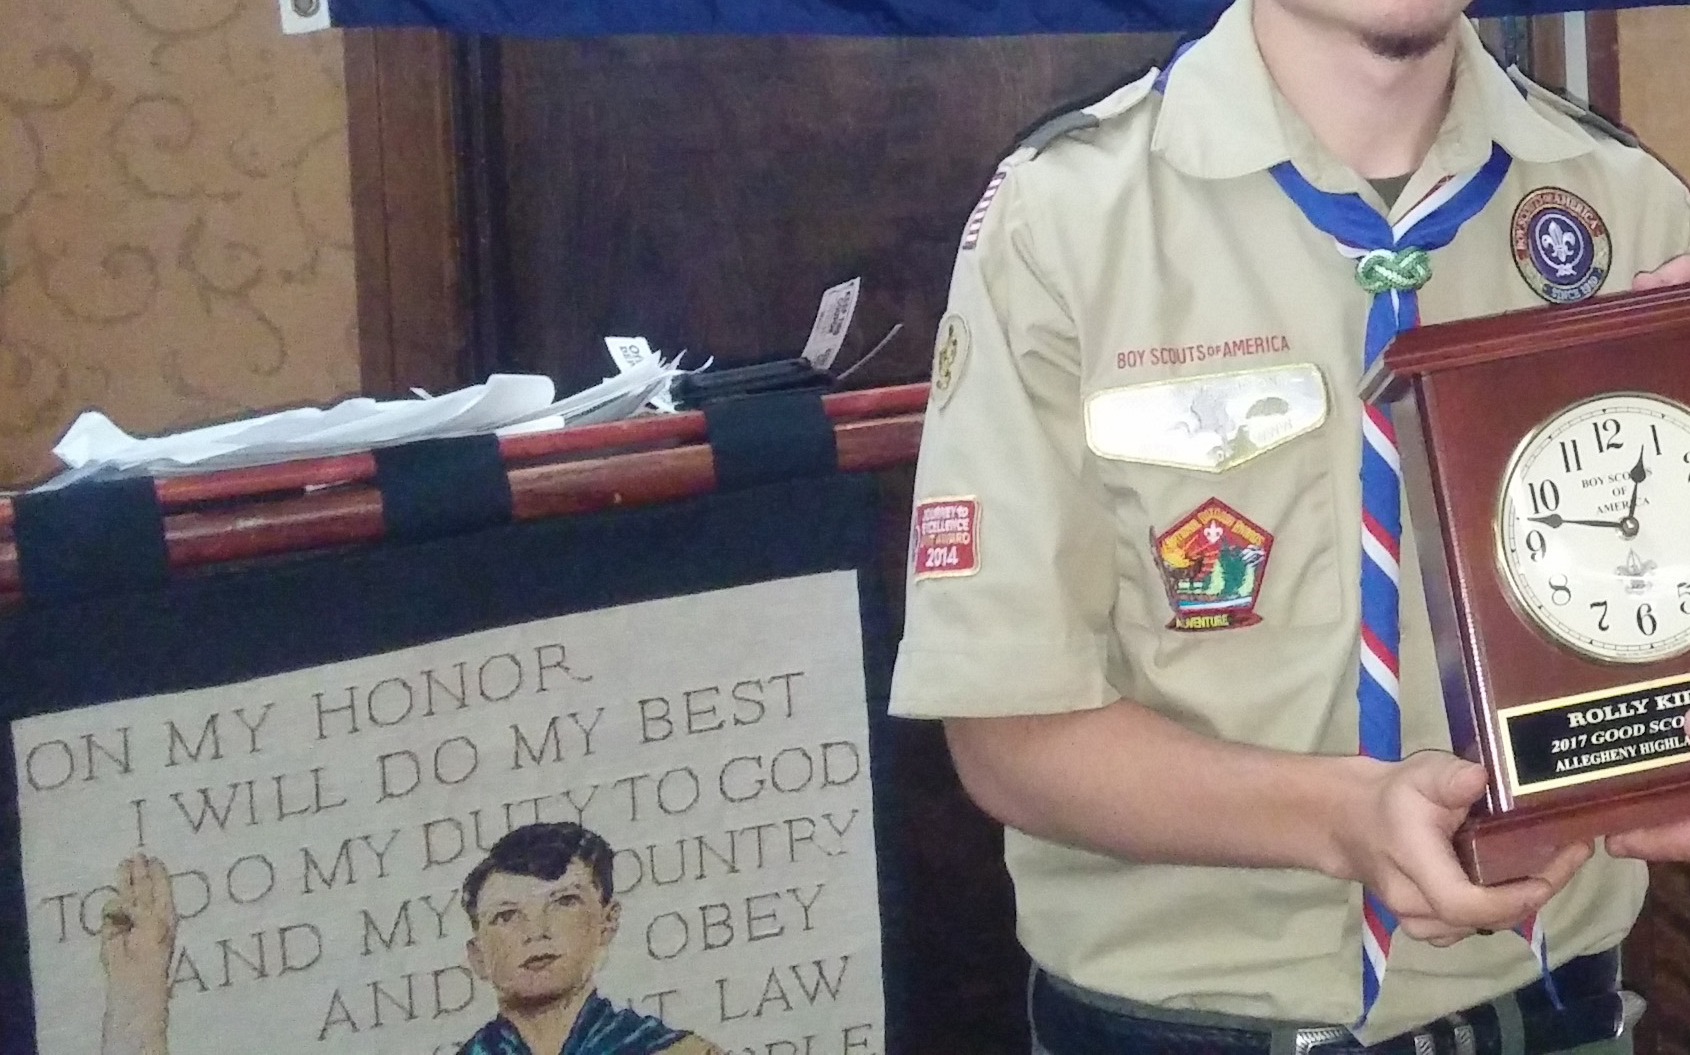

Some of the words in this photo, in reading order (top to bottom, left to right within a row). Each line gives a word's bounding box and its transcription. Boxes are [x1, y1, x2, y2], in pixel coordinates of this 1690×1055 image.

[1116, 350, 1146, 369] BOY
[1150, 344, 1206, 366] SCOUTS
[1223, 335, 1291, 358] AMERICA
[1592, 418, 1624, 454] 12
[1650, 424, 1663, 456] 1
[1559, 439, 1583, 473] 11
[1581, 476, 1604, 489] BOY
[1608, 468, 1653, 484] SCOS
[1612, 486, 1627, 497] OF
[1528, 478, 1560, 515] 10
[1597, 497, 1650, 514] AMERCA
[925, 546, 959, 567] 2014
[1525, 529, 1547, 562] 9
[1548, 573, 1572, 606] 8
[1590, 600, 1610, 632] 7
[1636, 602, 1658, 636] 6
[26, 727, 134, 791] ON
[164, 702, 276, 768] MY
[311, 643, 593, 740] HONOR
[1567, 696, 1650, 728] ROLLY
[1551, 734, 1587, 754] 2017
[1590, 721, 1646, 745] GOOD
[1649, 714, 1686, 734] SCO
[131, 799, 147, 847] I
[169, 767, 348, 835] WILL
[376, 735, 479, 804] DO
[510, 707, 605, 770] MY
[638, 671, 805, 744] BEST
[1555, 744, 1638, 773] ALLEGHENY
[169, 853, 275, 920] DO
[300, 829, 401, 894] MY
[422, 784, 600, 870] DUTY
[613, 766, 700, 821] TO
[719, 740, 860, 803] GOD
[168, 922, 322, 999] AND
[360, 888, 460, 957] MY
[612, 808, 860, 895] OUNTRY
[318, 965, 475, 1042] AND
[646, 883, 826, 962] OBEY
[715, 955, 851, 1023] LAW
